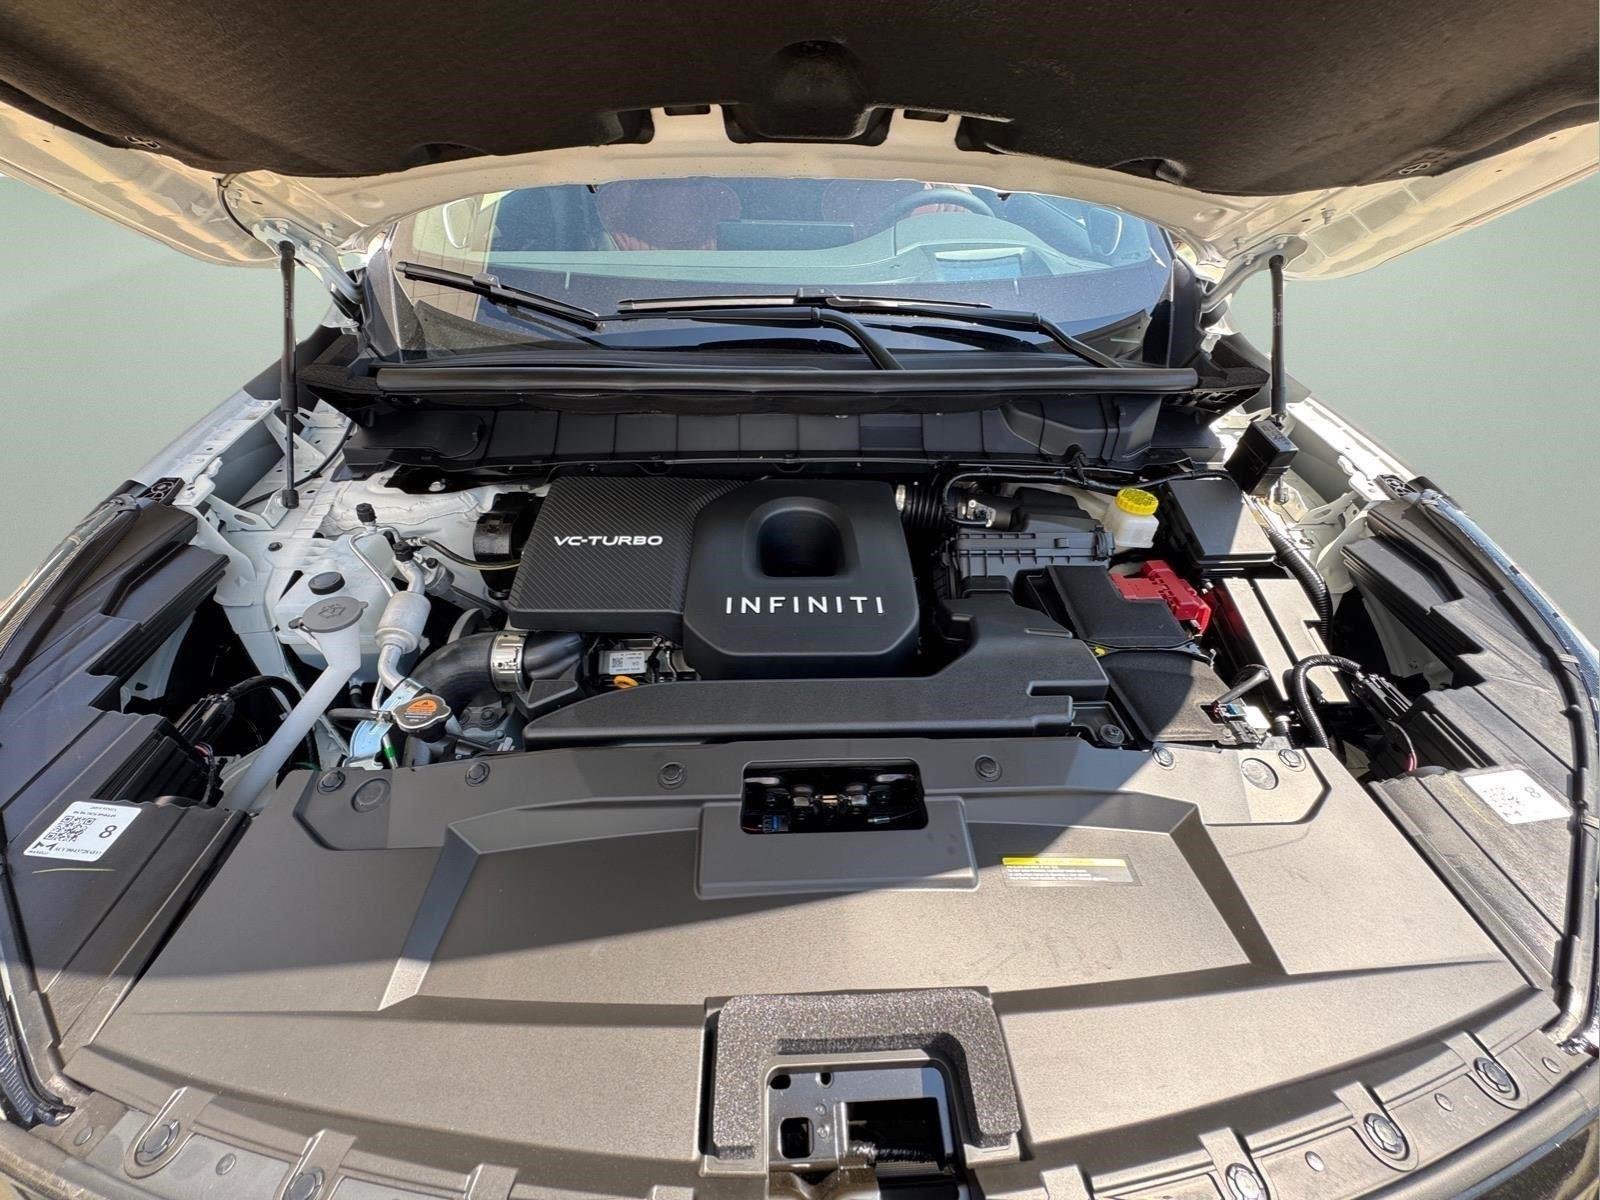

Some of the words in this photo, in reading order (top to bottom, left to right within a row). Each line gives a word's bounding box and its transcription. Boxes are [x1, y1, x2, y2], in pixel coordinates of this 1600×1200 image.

[553, 535, 664, 547] VC-TURBO
[725, 596, 884, 614] INFINITI
[1524, 786, 1542, 799] 8
[98, 825, 118, 839] 8
